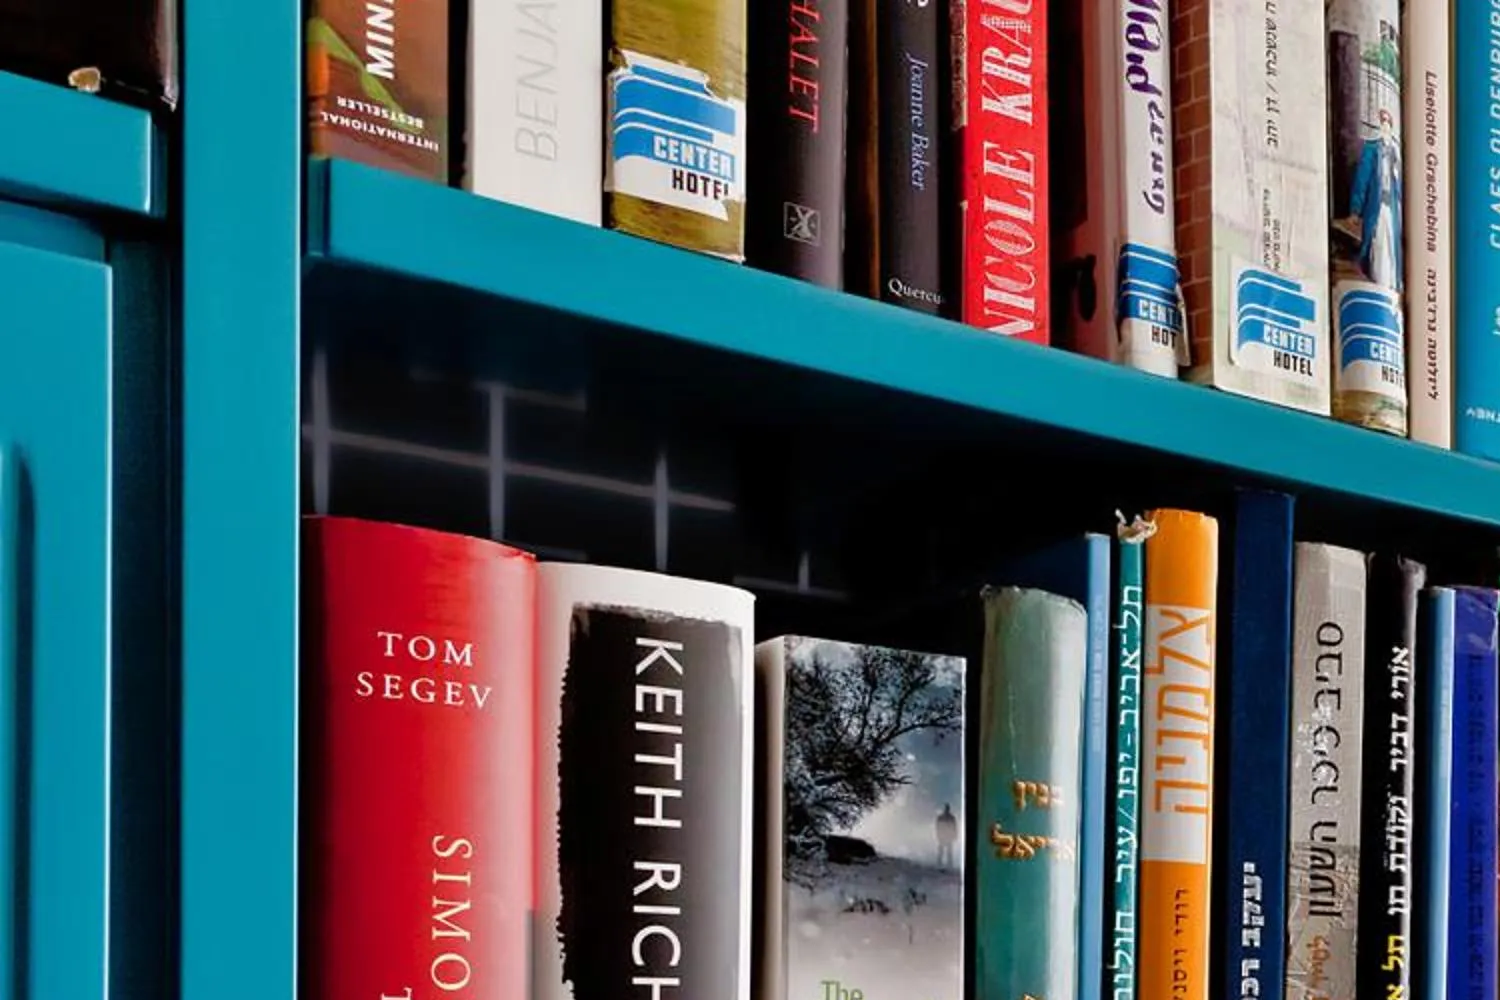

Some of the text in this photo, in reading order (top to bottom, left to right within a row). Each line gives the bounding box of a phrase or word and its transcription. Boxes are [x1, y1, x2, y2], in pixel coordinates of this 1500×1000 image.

[366, 0, 395, 80] MIN
[320, 111, 439, 152] INTERNATIONAL
[336, 95, 424, 129] BESTSELLER
[906, 52, 930, 191] Joanne Baker
[1424, 70, 1438, 147] Liselotte
[652, 134, 736, 180] CENTER
[1262, 323, 1315, 356] CENTER
[1272, 350, 1314, 378] HOTEL
[376, 631, 474, 667] TOM
[1112, 584, 1143, 727] תל-אביב
[1314, 620, 1346, 712] סביב
[1390, 646, 1412, 701] אורי
[355, 671, 493, 710] SEGEV
[1143, 607, 1212, 817] צלמניה
[634, 636, 684, 830] KEITH
[1390, 712, 1411, 773] דביר
[1310, 723, 1342, 806] כיכר
[1115, 825, 1139, 885] עיר
[1306, 819, 1344, 919] השעון
[1172, 888, 1190, 939] רודי
[1240, 861, 1266, 950] יעקב
[1380, 934, 1407, 971] תל
